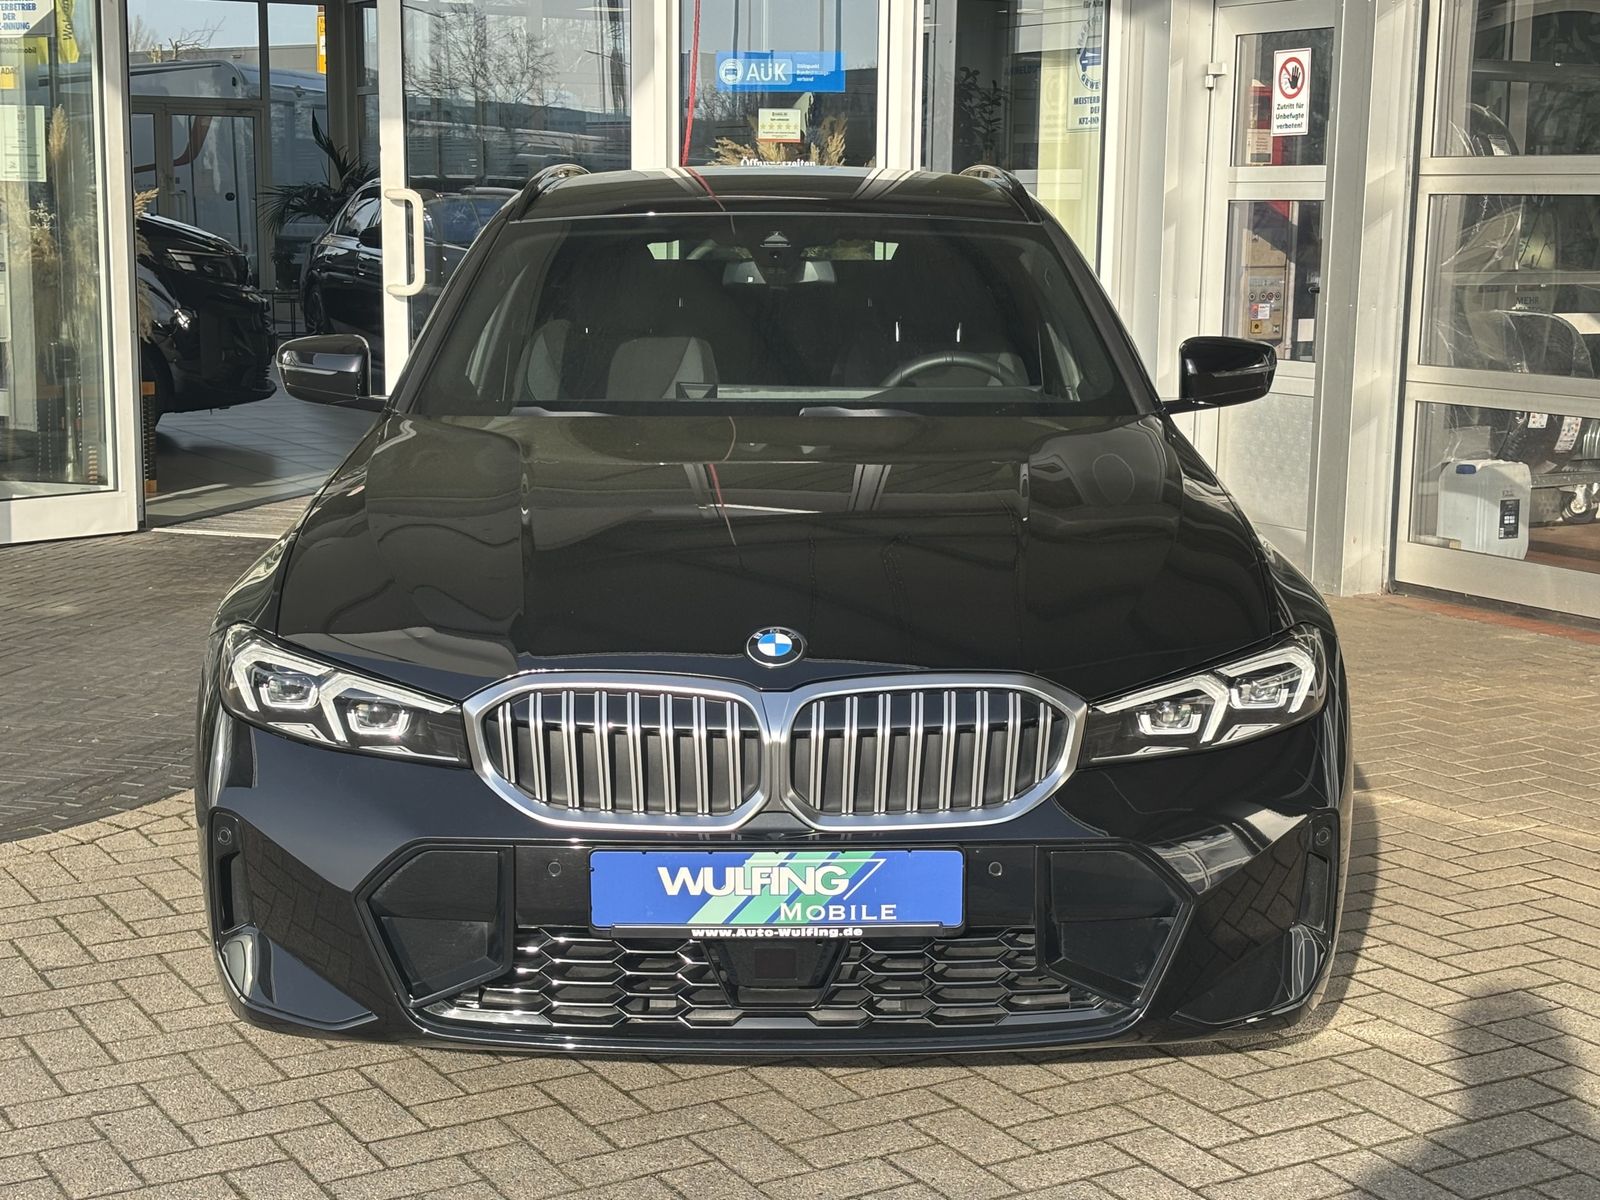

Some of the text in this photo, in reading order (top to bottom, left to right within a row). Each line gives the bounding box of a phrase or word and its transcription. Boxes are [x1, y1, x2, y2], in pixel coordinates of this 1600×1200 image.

[746, 63, 787, 81] AÜK
[1275, 112, 1305, 120] Unbefugte
[1276, 122, 1303, 130] verboten!
[656, 866, 850, 897] WULFING
[691, 927, 863, 938] www.Auto-Wulfing.de
